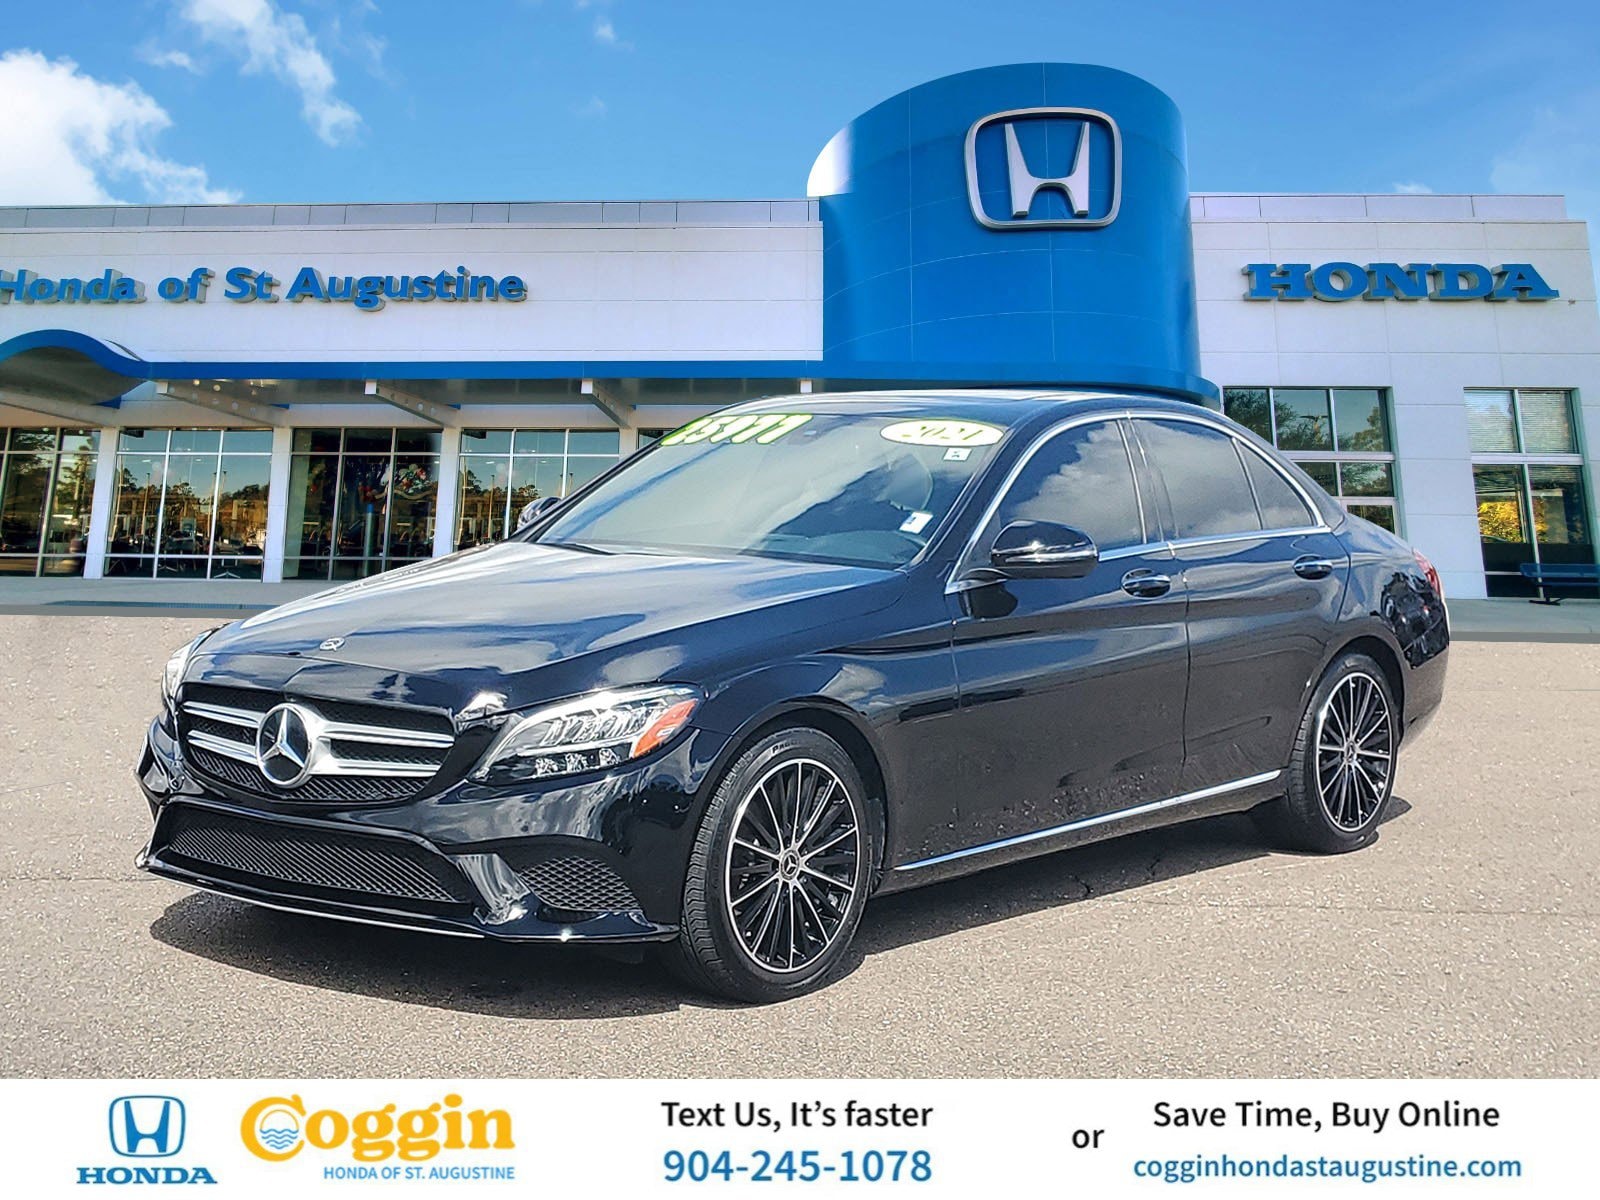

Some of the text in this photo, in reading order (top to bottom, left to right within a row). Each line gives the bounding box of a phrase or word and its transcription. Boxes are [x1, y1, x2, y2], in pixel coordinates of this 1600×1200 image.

[158, 267, 211, 303] of
[224, 267, 276, 303] St
[286, 266, 526, 311] Augustine
[1244, 262, 1560, 301] HONDA
